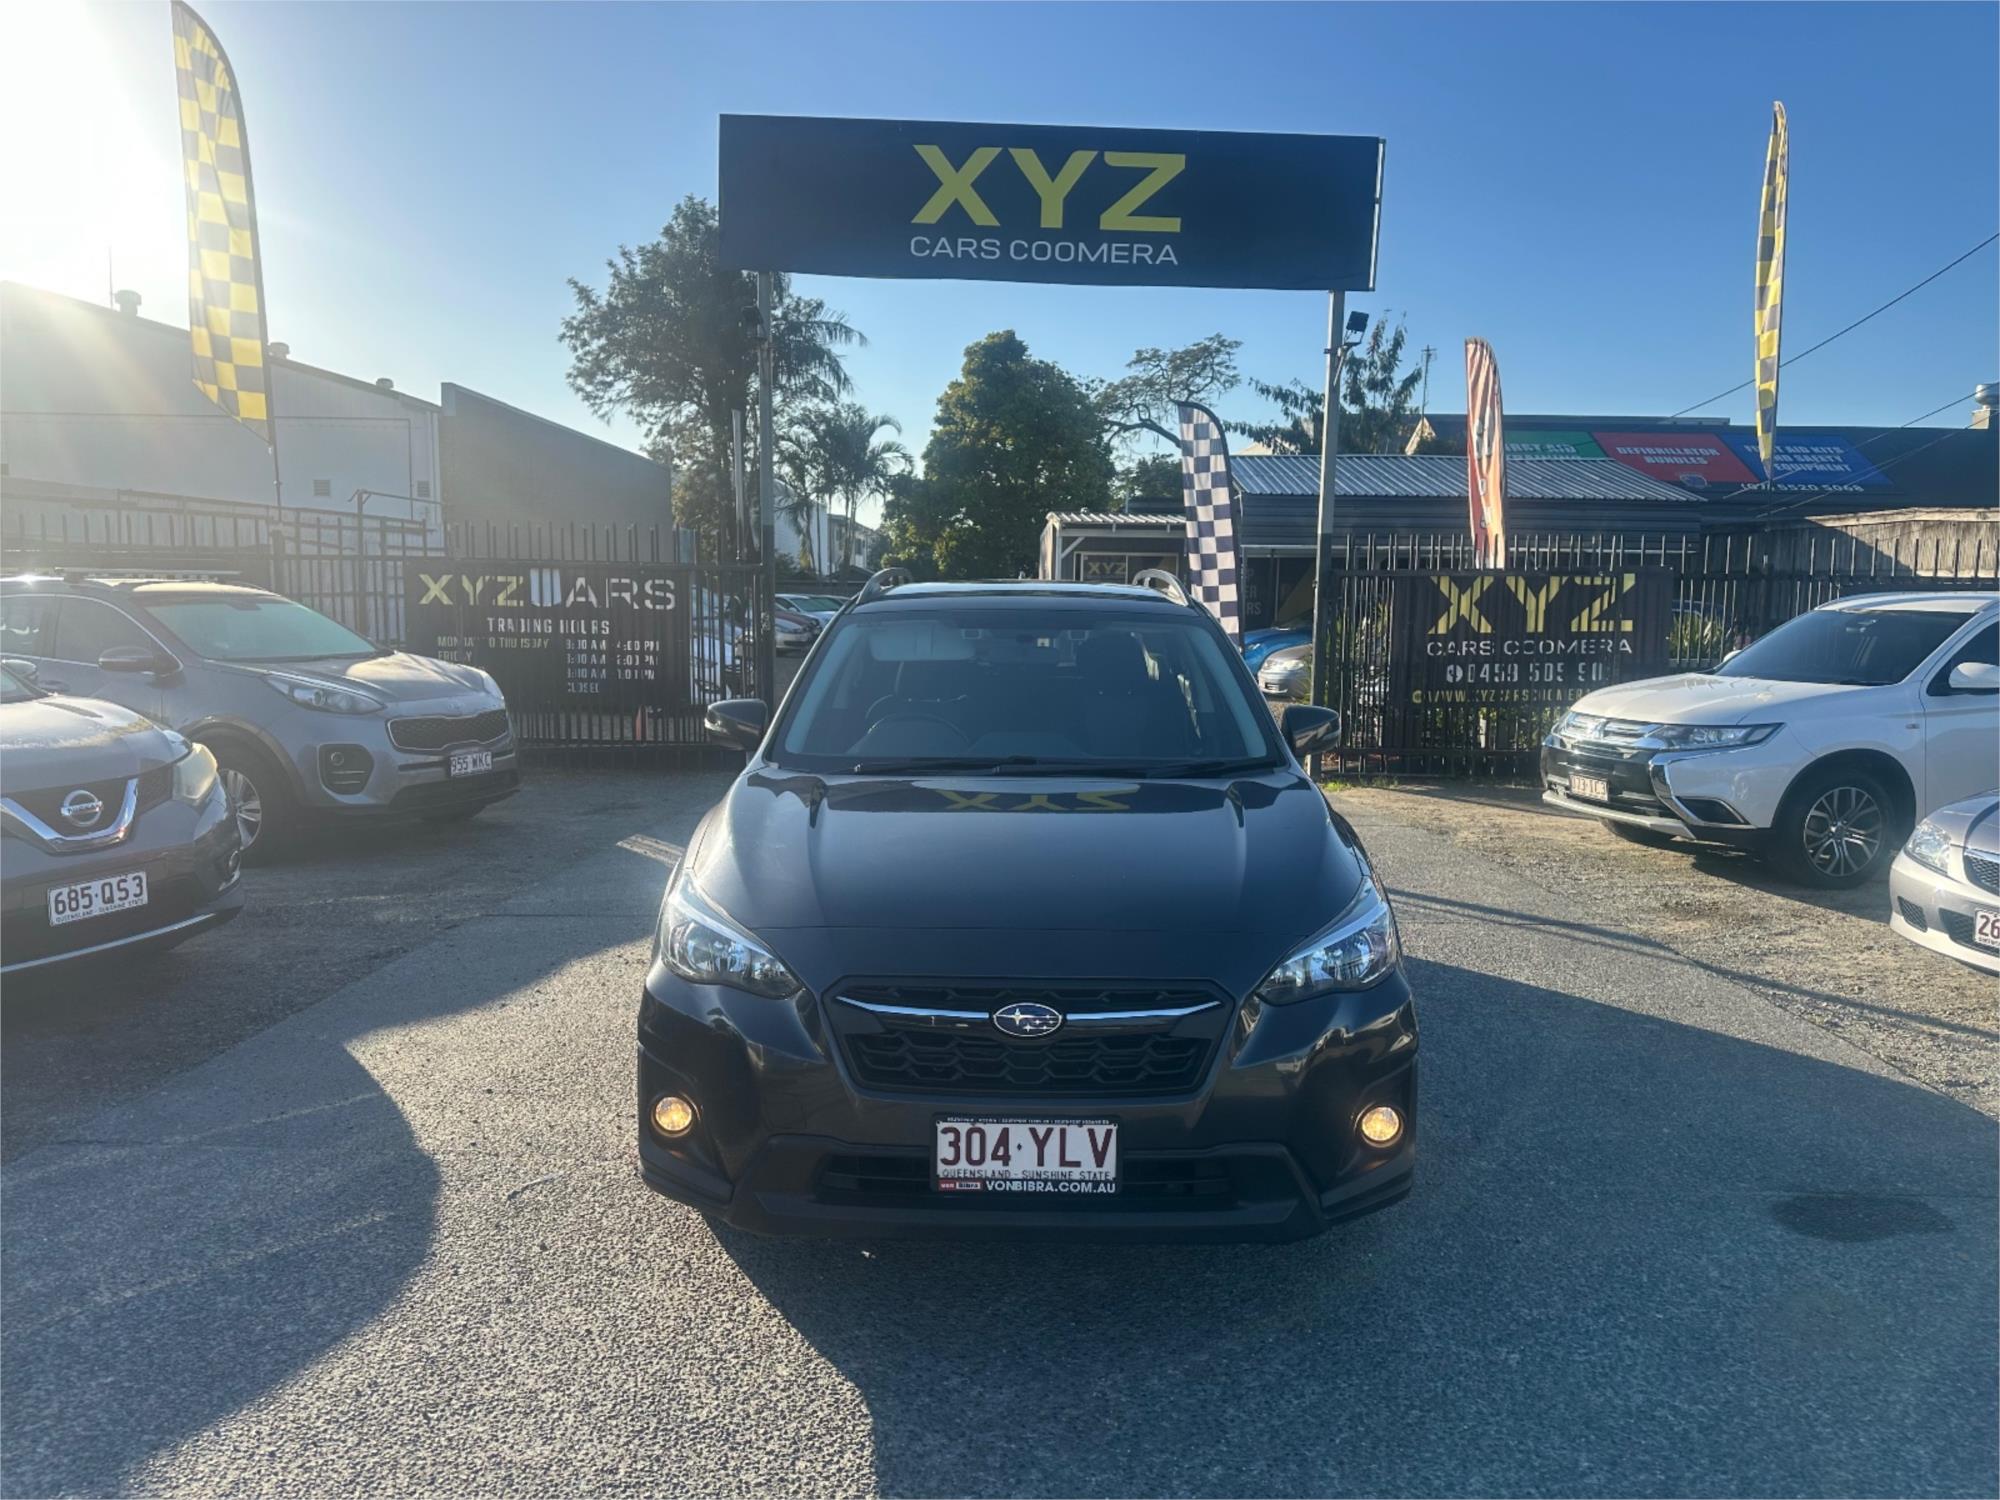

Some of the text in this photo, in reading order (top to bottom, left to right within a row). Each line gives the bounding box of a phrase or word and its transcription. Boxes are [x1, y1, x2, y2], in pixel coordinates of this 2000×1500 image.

[910, 144, 1187, 233] XYZ
[910, 236, 1179, 266] CARS COOMERA
[1505, 443, 1546, 453] IRST
[1616, 446, 1721, 457] DEFIBRILLATOR
[1774, 463, 1853, 472] EQUIPMENT
[1087, 562, 1126, 574] XYZ
[418, 567, 676, 610] XYZ ARS
[1427, 573, 1636, 635] XYZ
[1427, 640, 1494, 656] CARS
[942, 1168, 1113, 1181] QUEENSLAND SUNSHINE STATE
[986, 1180, 1117, 1194] VONBIBRA.COM.AU
